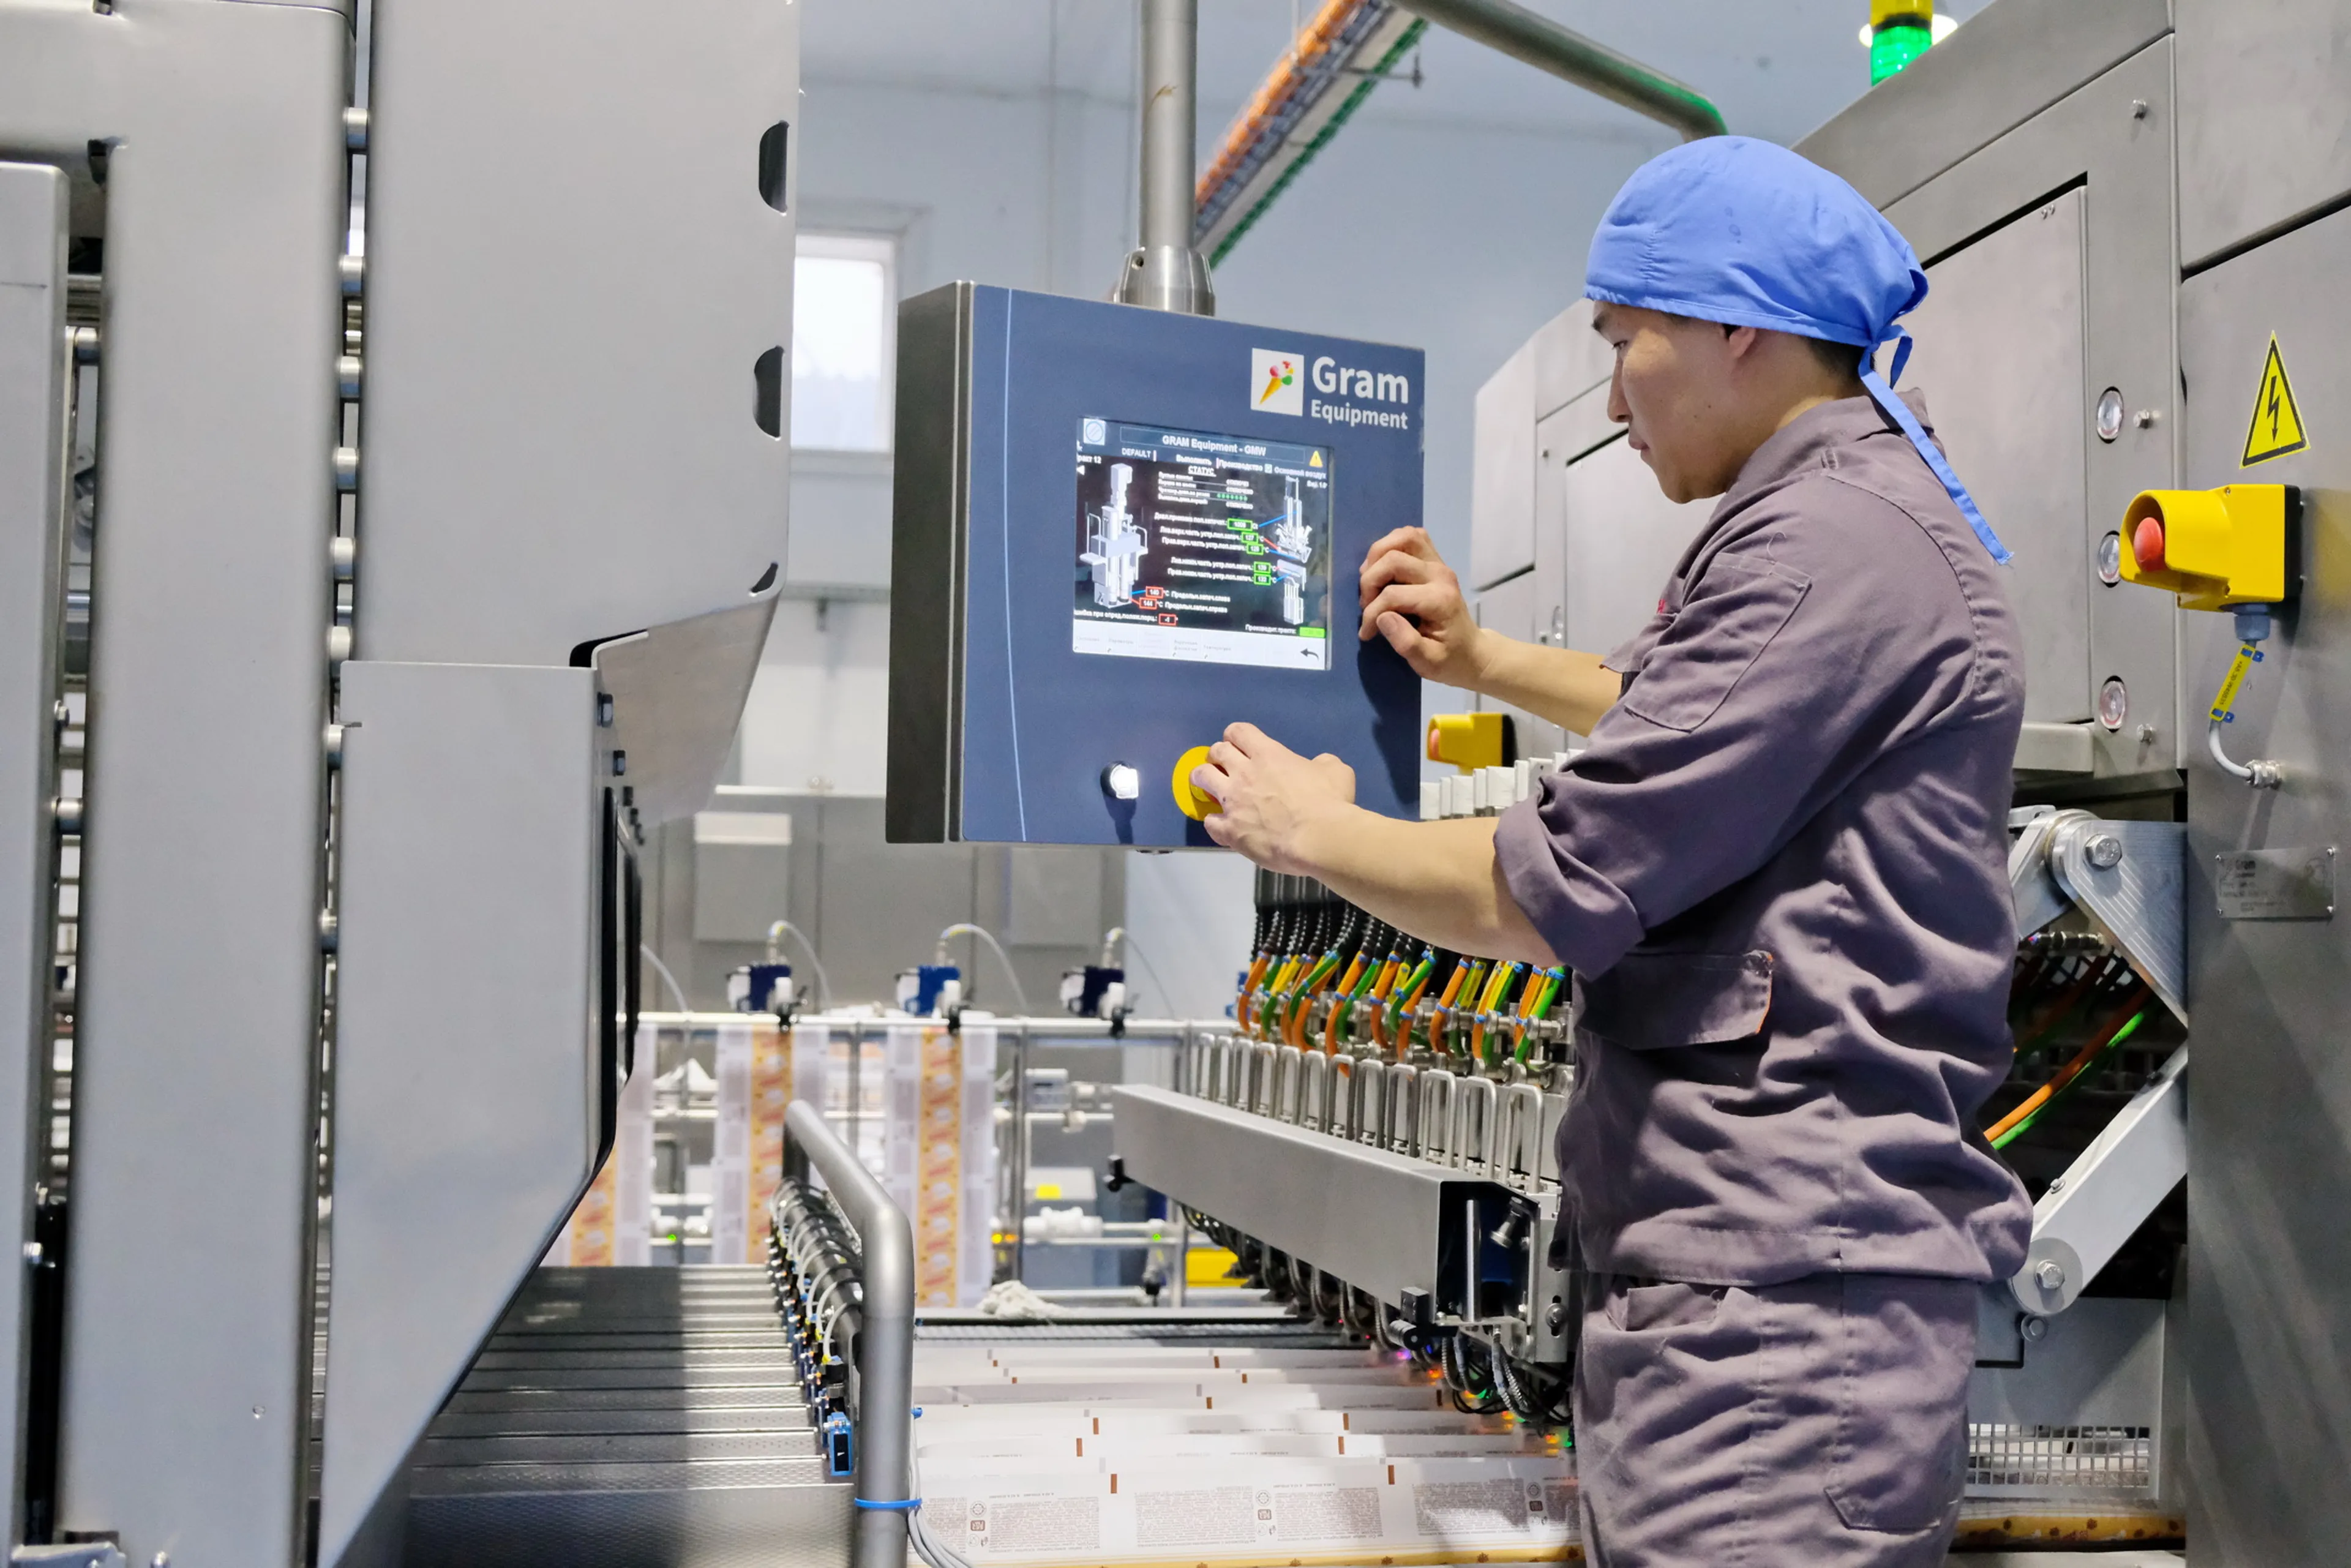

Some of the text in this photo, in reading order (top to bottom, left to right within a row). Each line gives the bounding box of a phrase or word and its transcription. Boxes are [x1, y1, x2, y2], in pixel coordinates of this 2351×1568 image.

[1312, 356, 1409, 404] Gram
[1311, 399, 1408, 430] Equipment
[1122, 448, 1152, 458] DEFAULT
[1162, 435, 1190, 447] GRAM
[1191, 438, 1238, 452] Equipment
[1244, 445, 1267, 456] GMW
